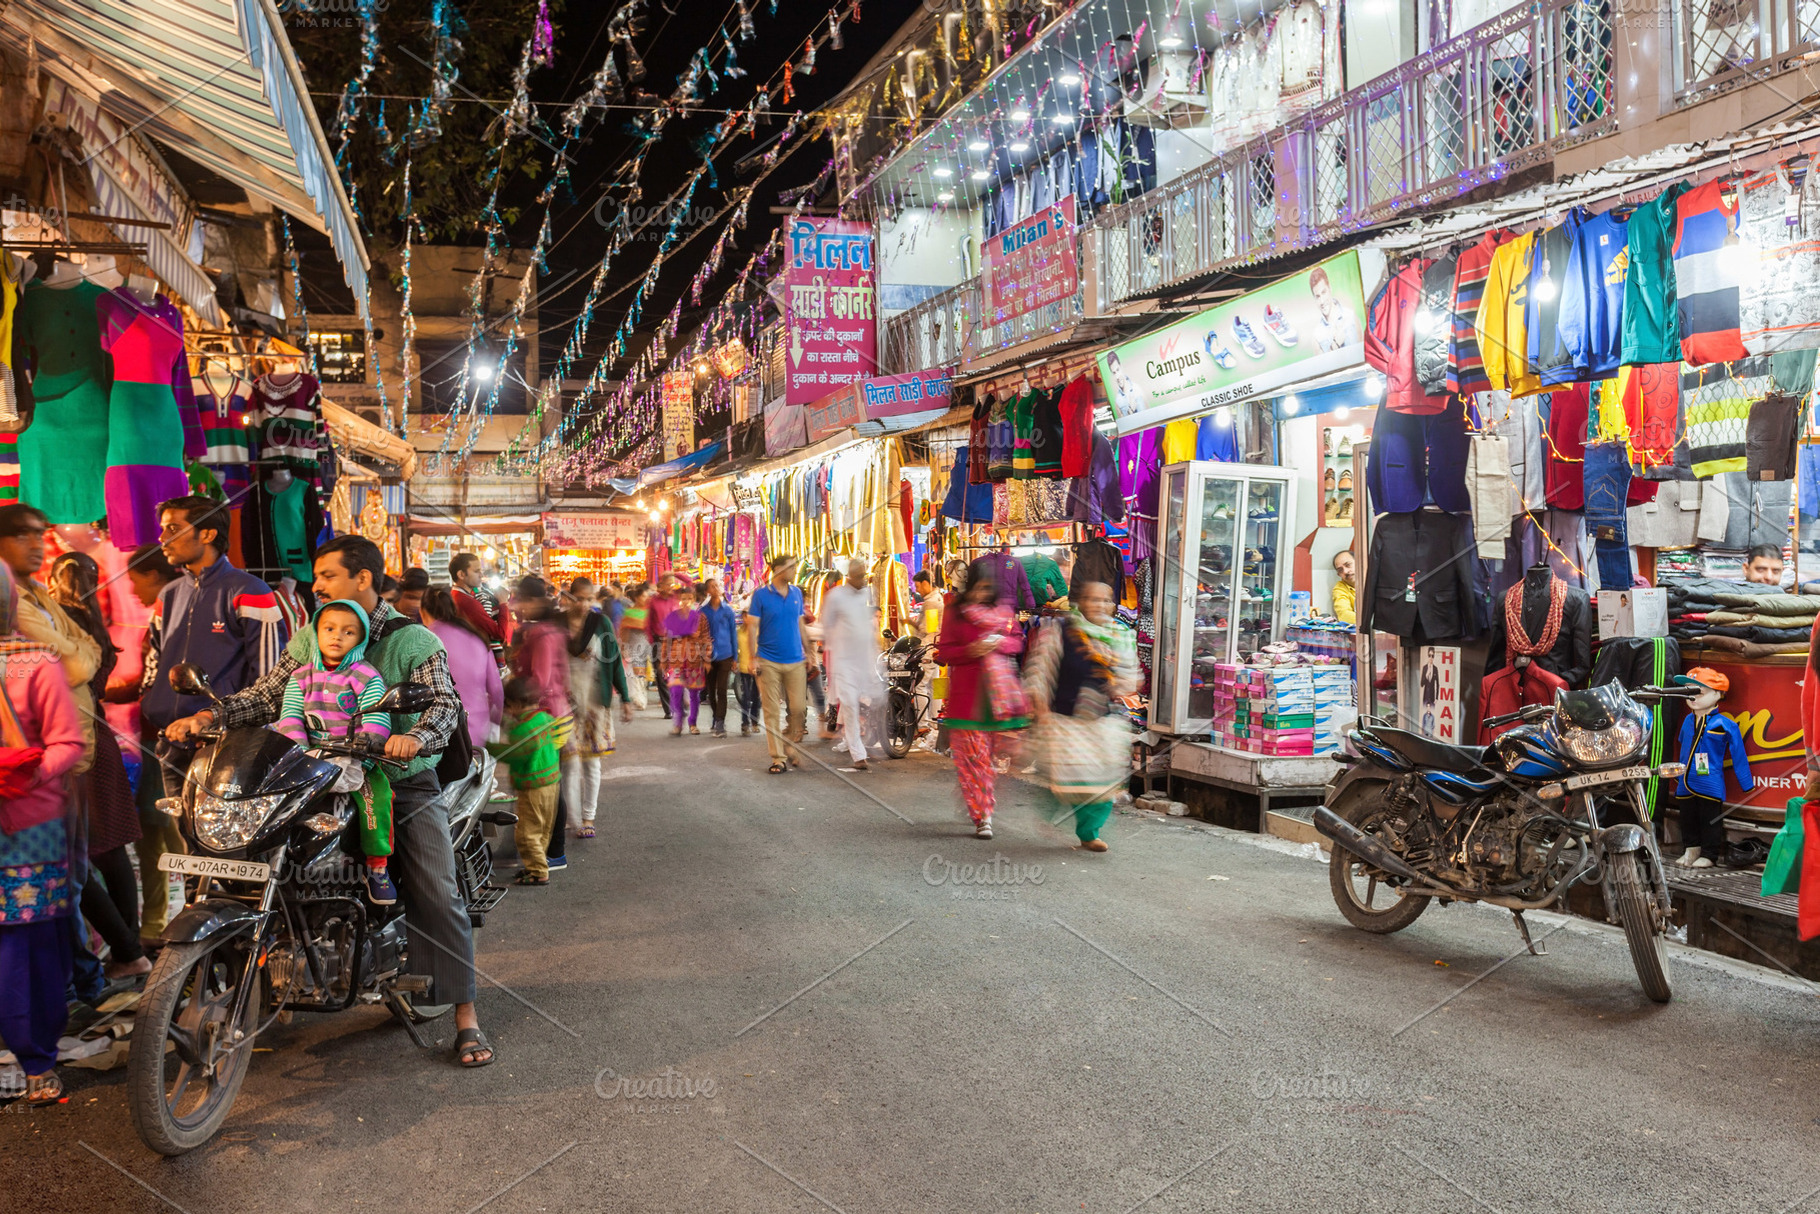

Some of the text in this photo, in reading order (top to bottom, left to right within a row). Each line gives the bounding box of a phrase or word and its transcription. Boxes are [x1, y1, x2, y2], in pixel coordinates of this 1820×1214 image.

[790, 220, 872, 271] मिलन
[1002, 211, 1064, 256] Milan's
[790, 275, 827, 328] साड़ी
[823, 327, 835, 342] की
[807, 349, 860, 363] का रास्ता नीचे
[1146, 350, 1201, 380] Campus
[792, 373, 817, 388] दुकान
[818, 370, 828, 384] के
[865, 382, 897, 407] मिलन
[898, 377, 924, 405] साड़ी
[1200, 383, 1254, 408] CLASSIC SHOE
[340, 694, 357, 710] 32
[1440, 651, 1454, 738] HIMAN
[168, 858, 264, 878] UK 07AR 1974
